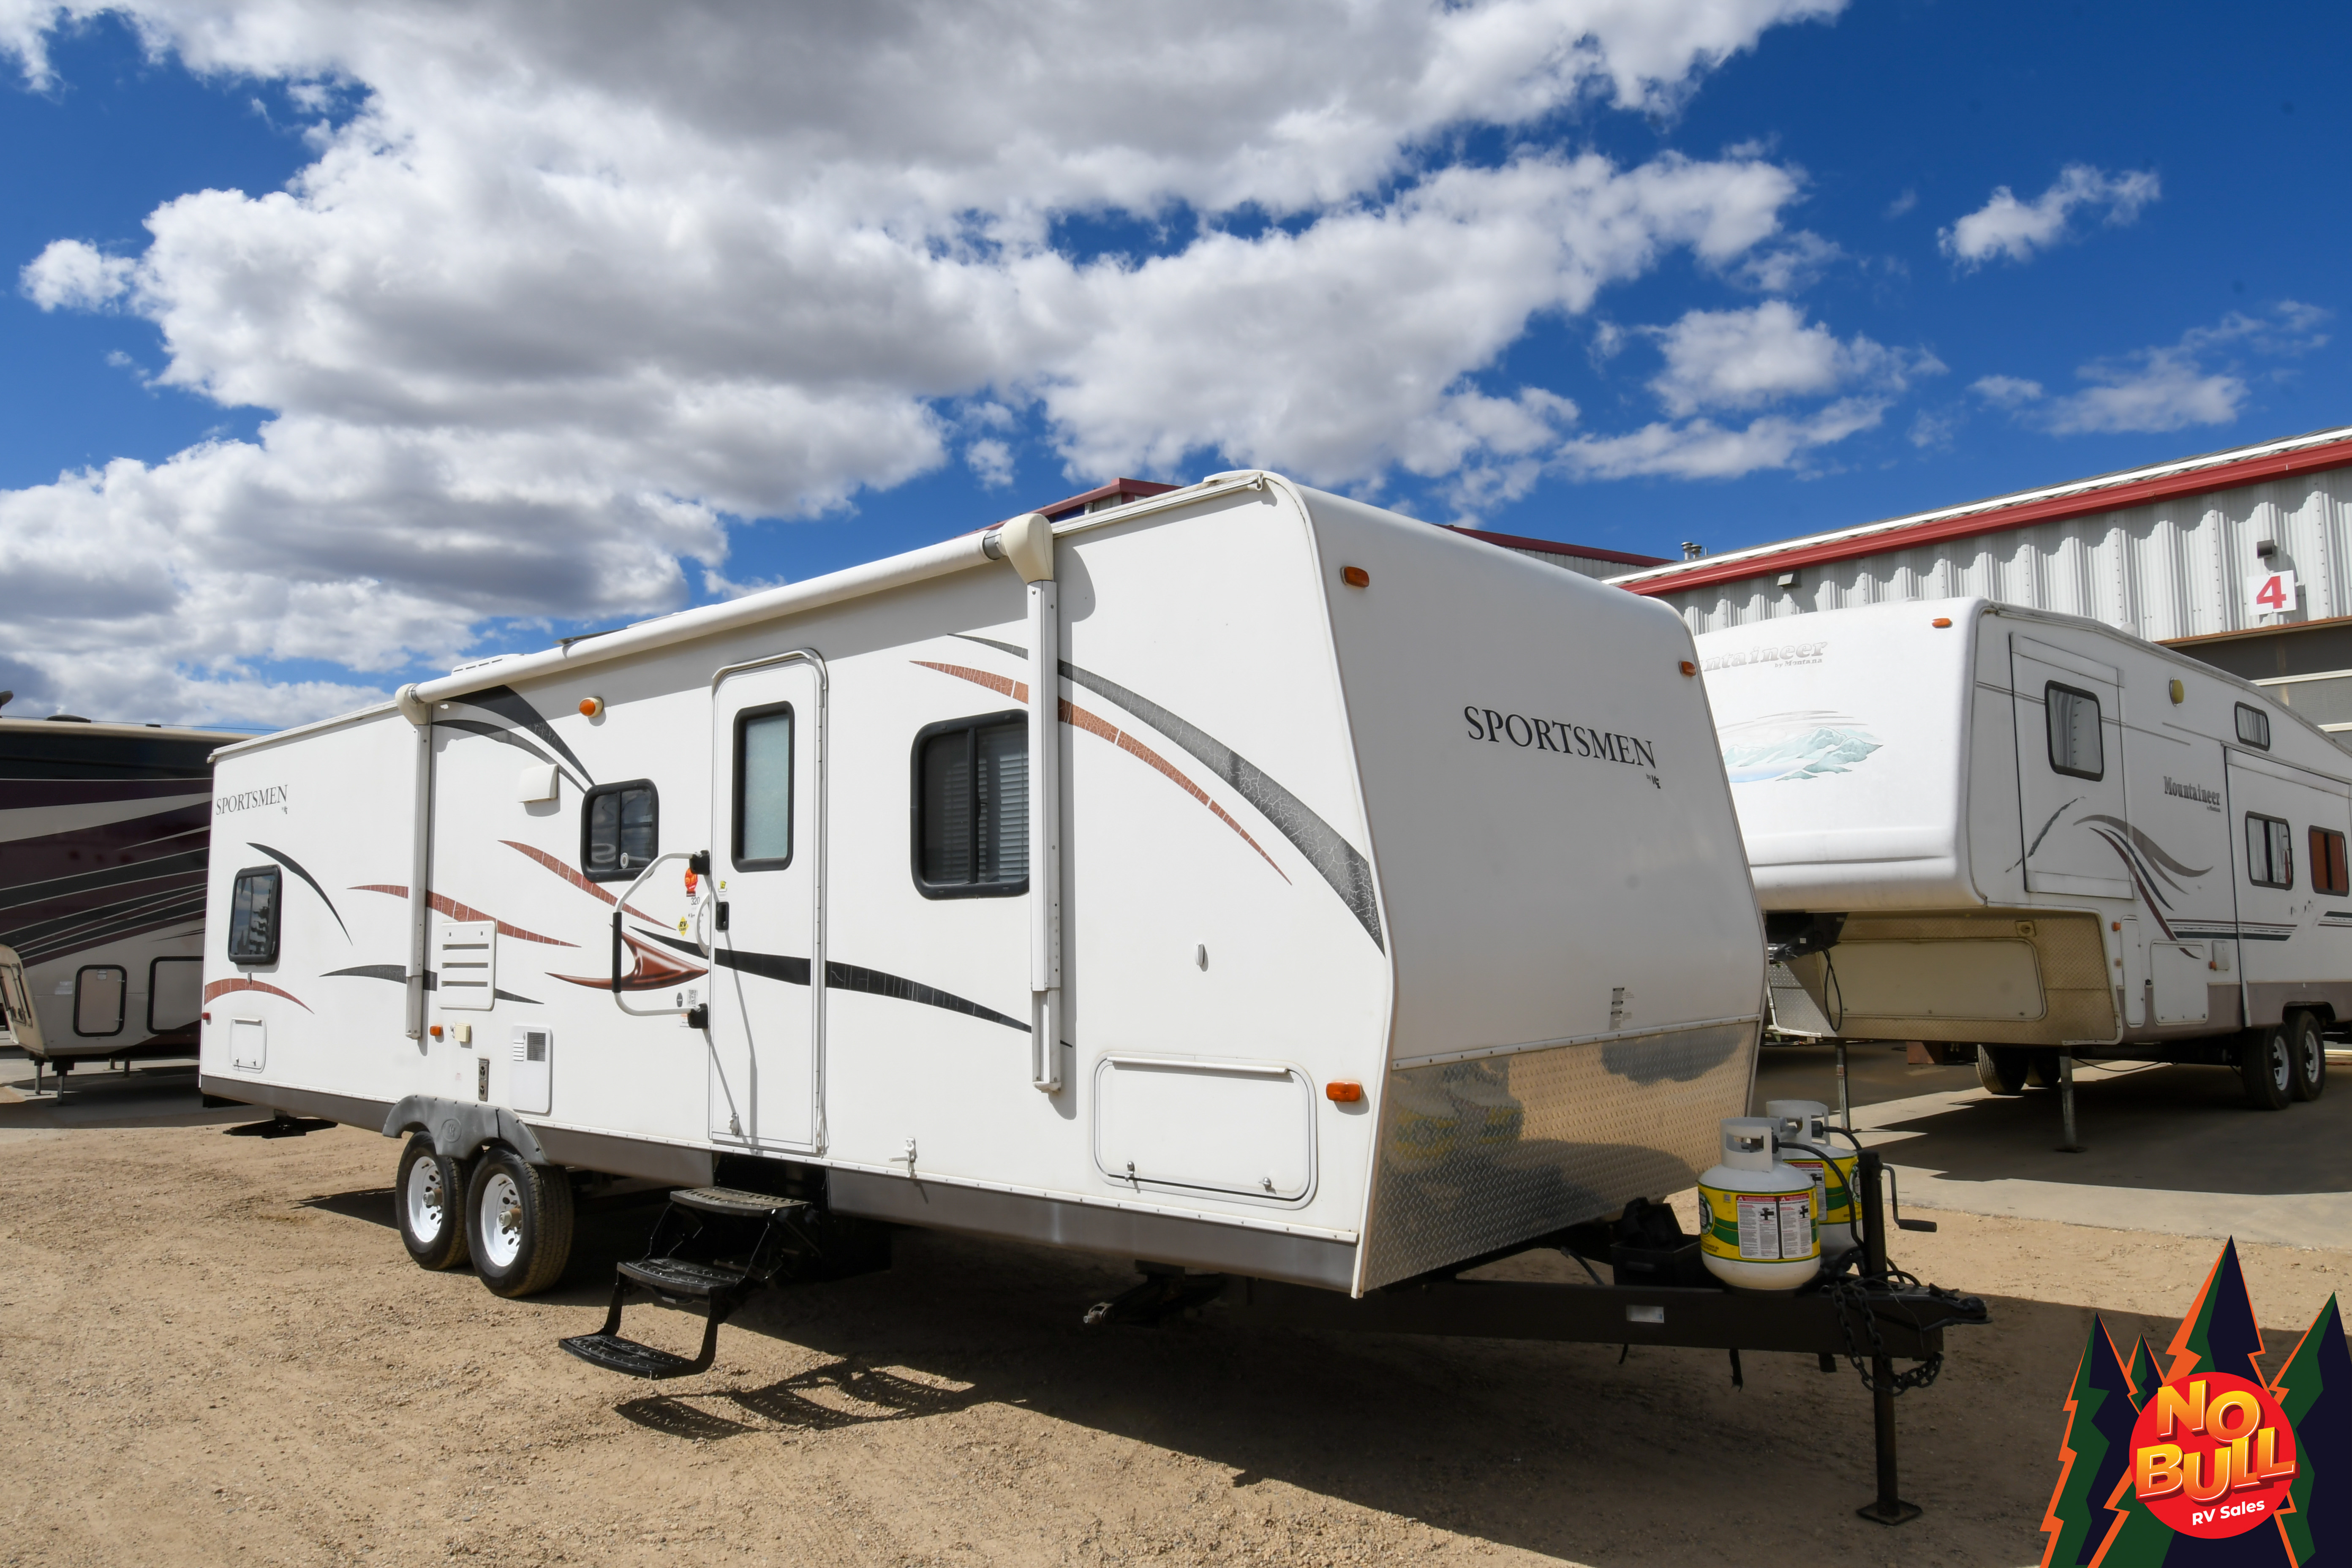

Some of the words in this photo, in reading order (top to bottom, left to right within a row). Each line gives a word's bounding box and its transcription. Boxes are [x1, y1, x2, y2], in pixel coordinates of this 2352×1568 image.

[2256, 576, 2287, 609] 4
[1700, 642, 1828, 672] ntaineer
[1784, 658, 1822, 667] Montana
[1464, 706, 1656, 769] SPORTSMEN
[216, 784, 288, 815] SPORTSMEN
[2163, 776, 2220, 806] Mountaineer
[691, 896, 700, 906] 320
